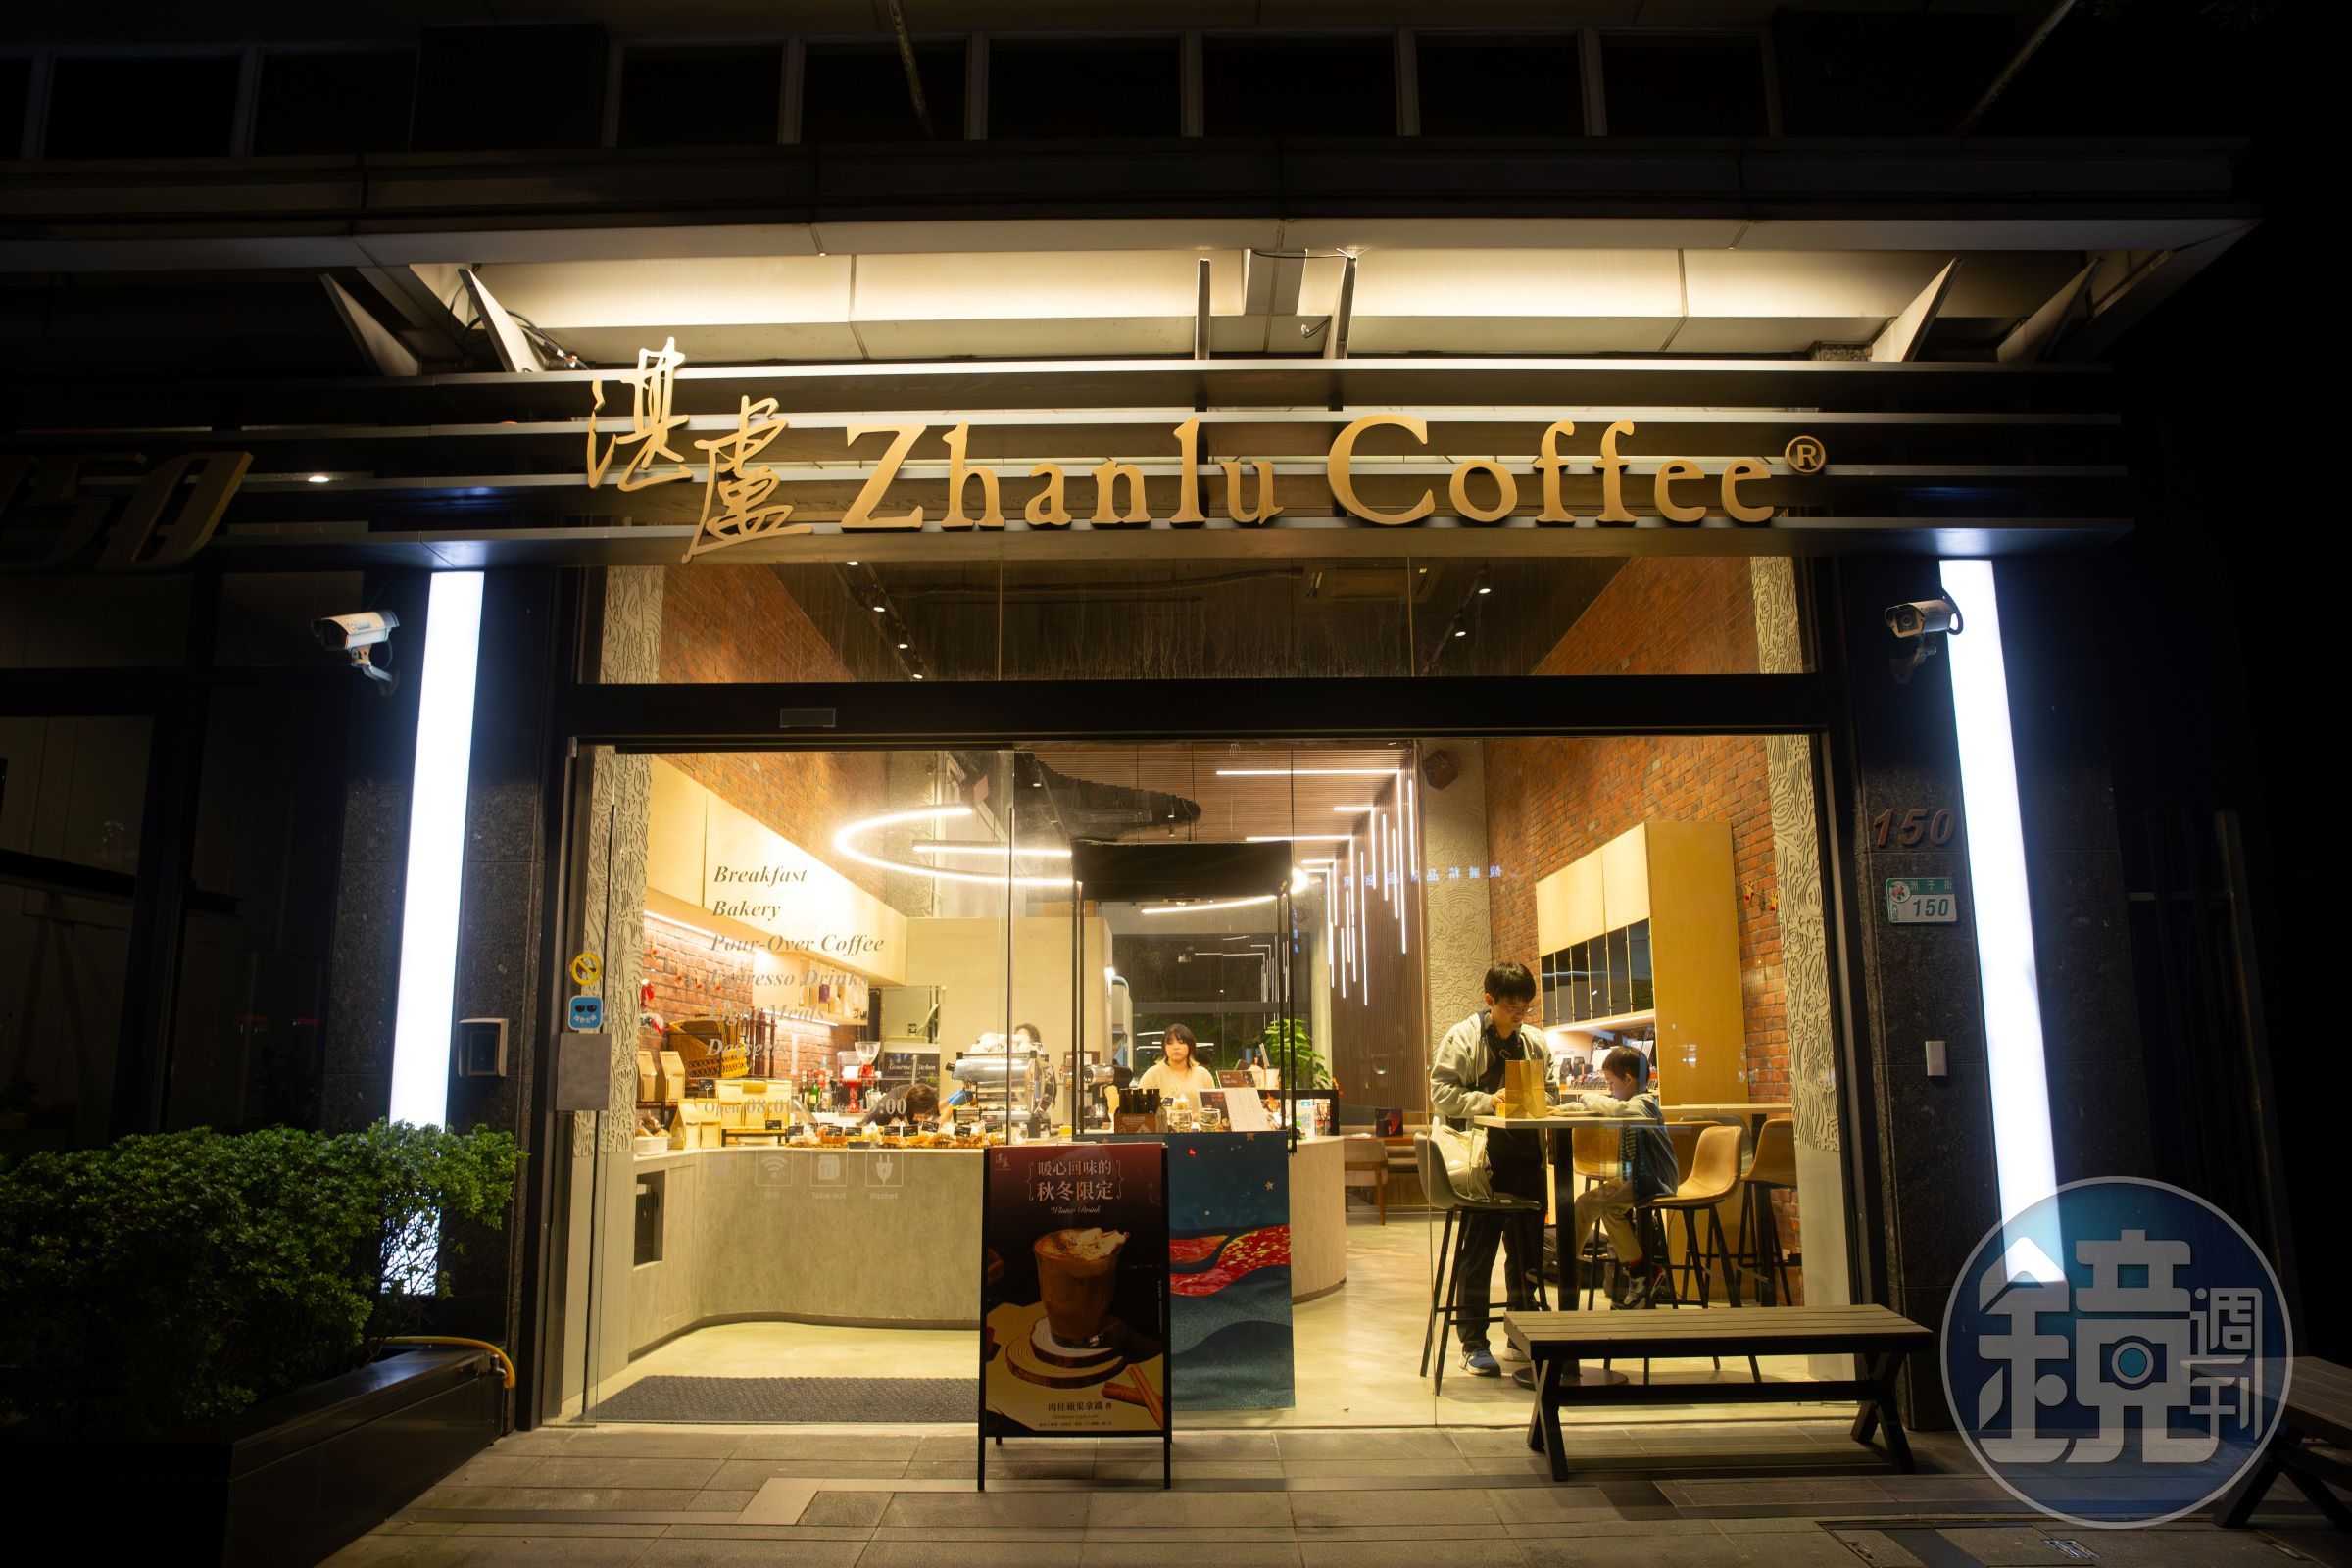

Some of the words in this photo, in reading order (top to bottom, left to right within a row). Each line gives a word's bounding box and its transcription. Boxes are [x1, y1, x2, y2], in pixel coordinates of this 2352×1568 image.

[586, 335, 813, 564] 湛盧
[840, 417, 1284, 530] Zhanlu
[1327, 414, 1775, 528] Coffee
[1874, 808, 1955, 846] 150
[713, 865, 808, 888] Breakfast
[711, 900, 781, 921] Bakery
[1913, 898, 1949, 917] 150
[710, 934, 814, 953] Pour-Over
[821, 934, 885, 956] Coffee
[705, 1101, 740, 1116] Open
[1037, 1159, 1112, 1176] 暖心回味的
[1036, 1179, 1115, 1202] 秋冬限定
